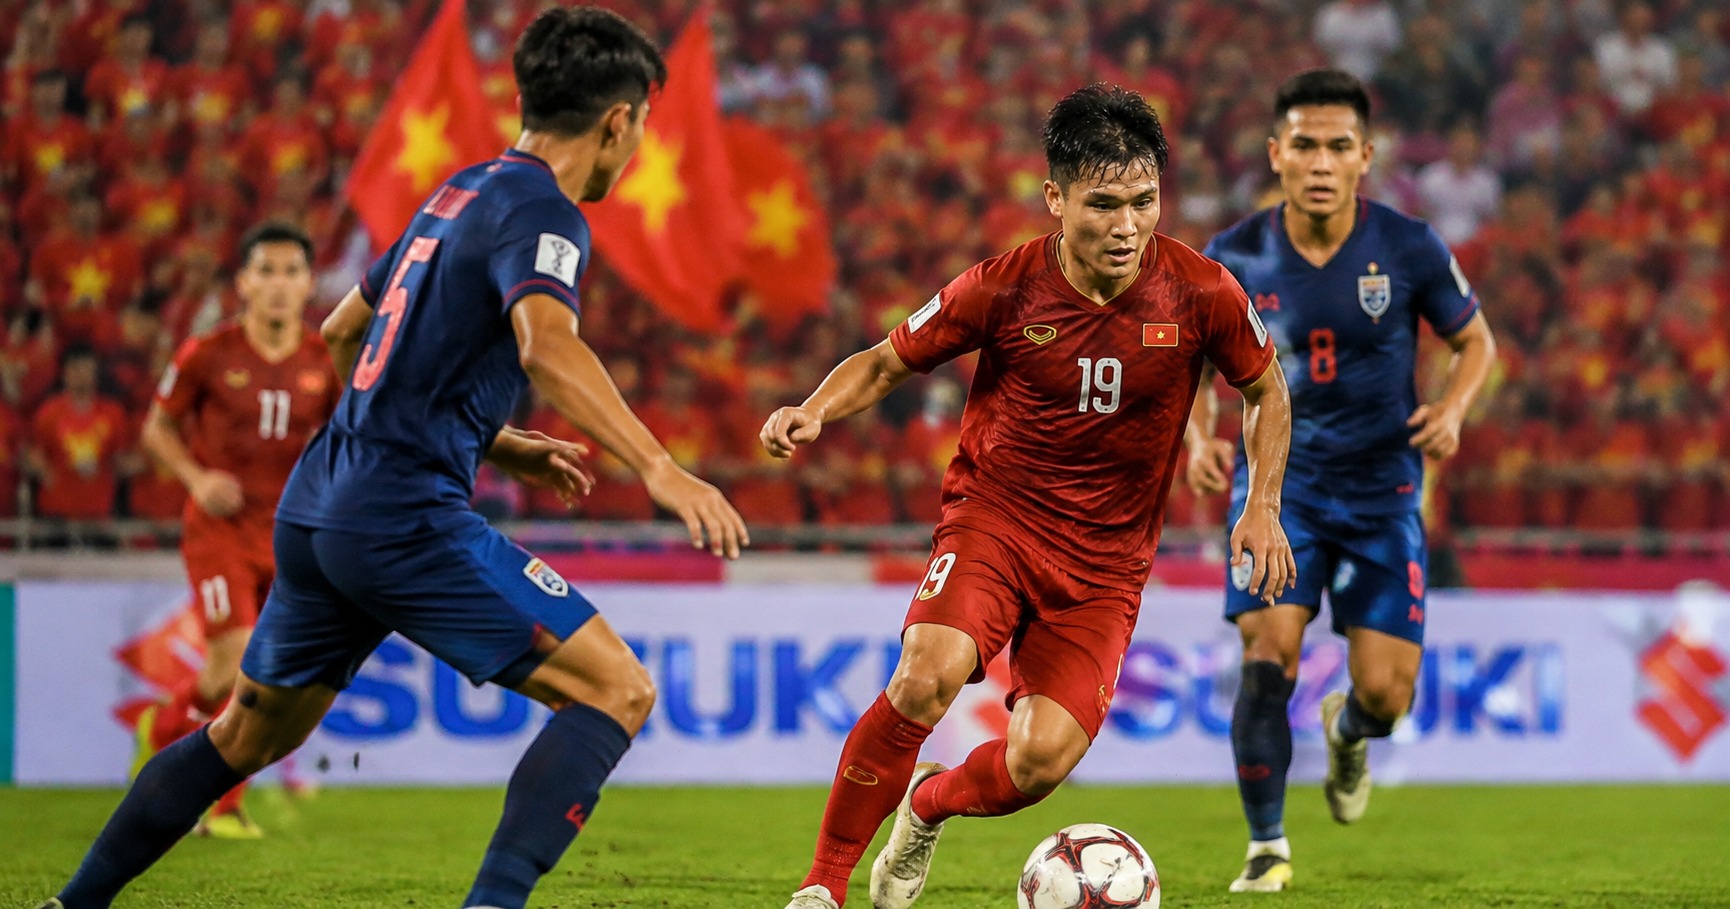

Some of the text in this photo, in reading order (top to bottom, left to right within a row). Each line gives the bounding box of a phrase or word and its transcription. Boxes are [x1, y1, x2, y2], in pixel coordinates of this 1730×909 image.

[352, 236, 439, 391] 5
[1309, 327, 1337, 384] 8
[1078, 357, 1122, 413] 19
[257, 389, 291, 440] 11
[200, 575, 231, 623] 11
[915, 552, 956, 600] 19
[319, 638, 902, 738] SUUK
